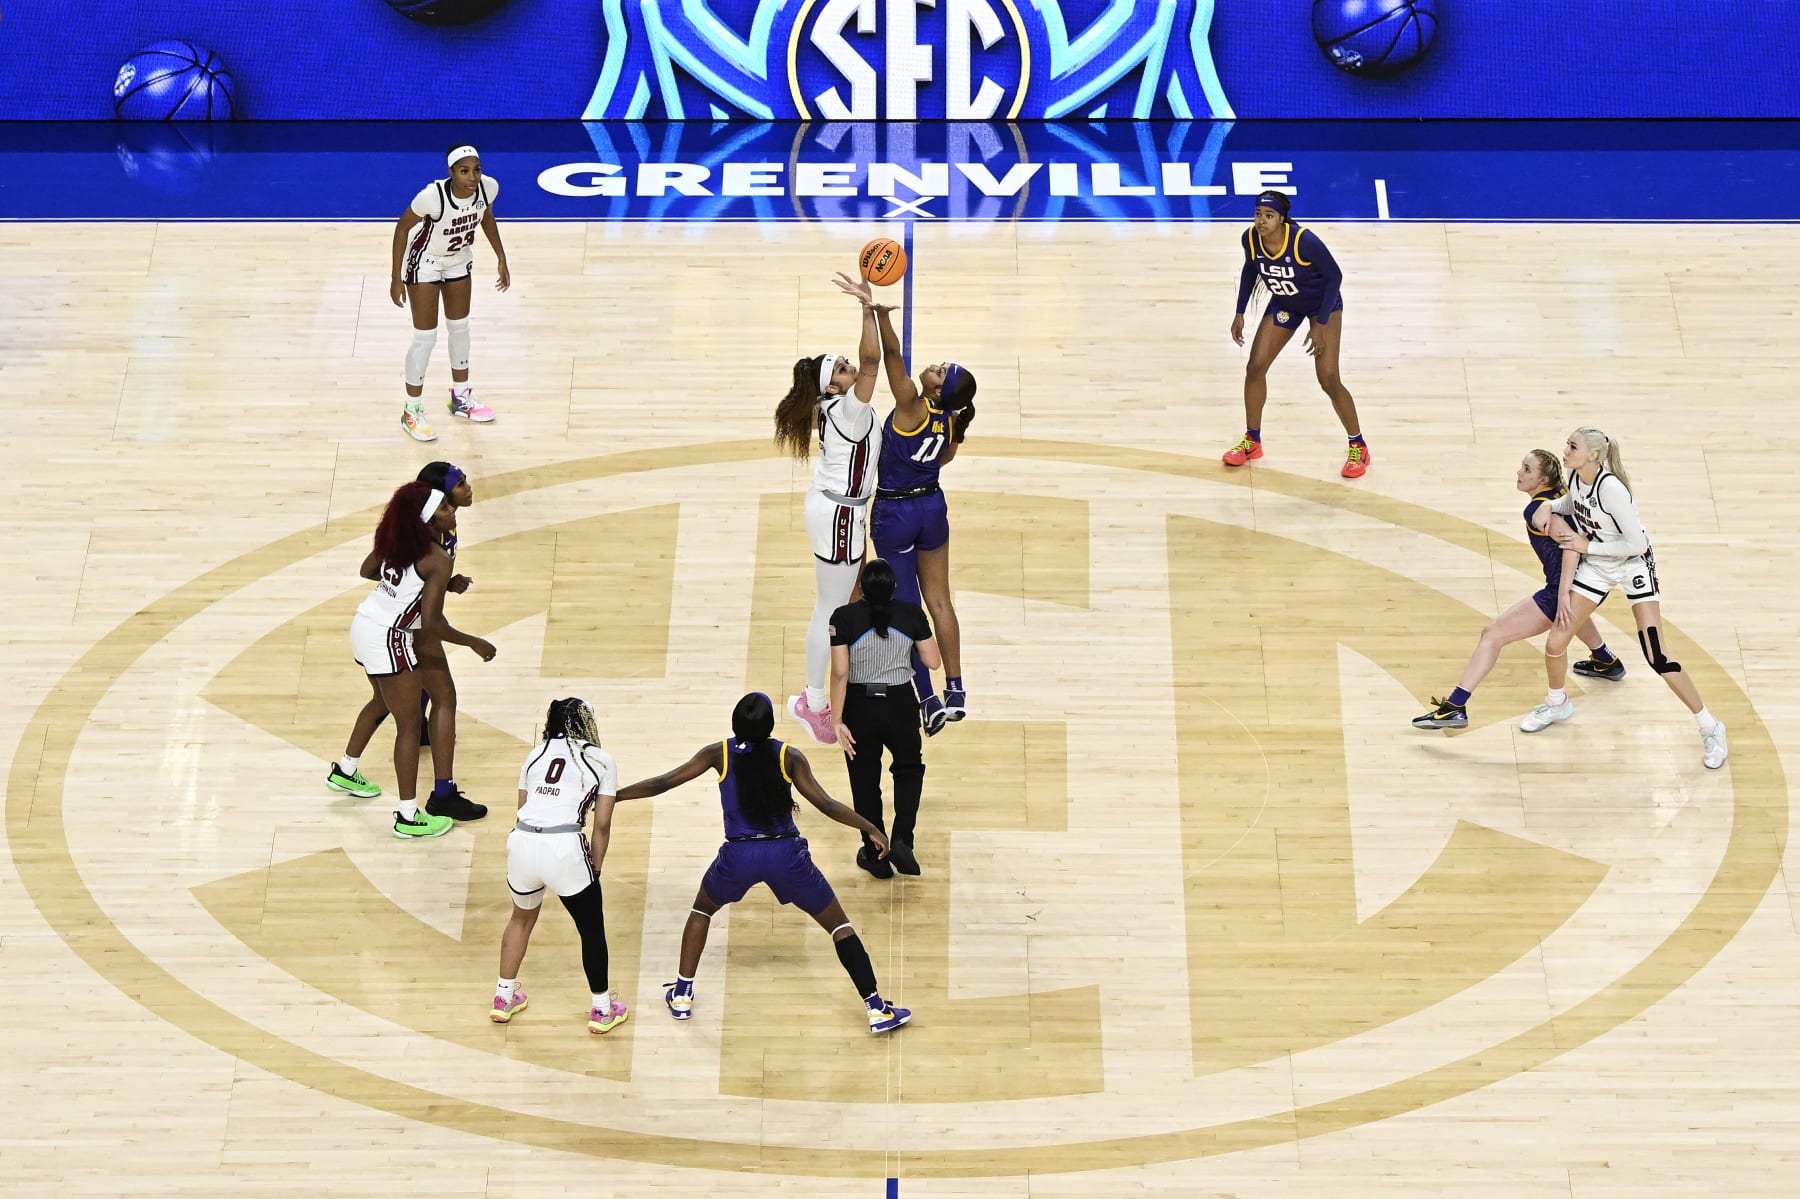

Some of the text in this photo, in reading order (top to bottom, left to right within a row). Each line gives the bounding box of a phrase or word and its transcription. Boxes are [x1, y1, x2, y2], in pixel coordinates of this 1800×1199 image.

[537, 162, 1298, 198] GREENVILLE
[451, 212, 478, 227] SOUTH
[447, 230, 476, 252] 23
[875, 249, 893, 273] NCAA
[1259, 262, 1295, 279] LSU
[1267, 278, 1300, 296] 20
[838, 517, 848, 548] USC
[545, 757, 567, 785] 0
[535, 786, 561, 797] PAOPAO
